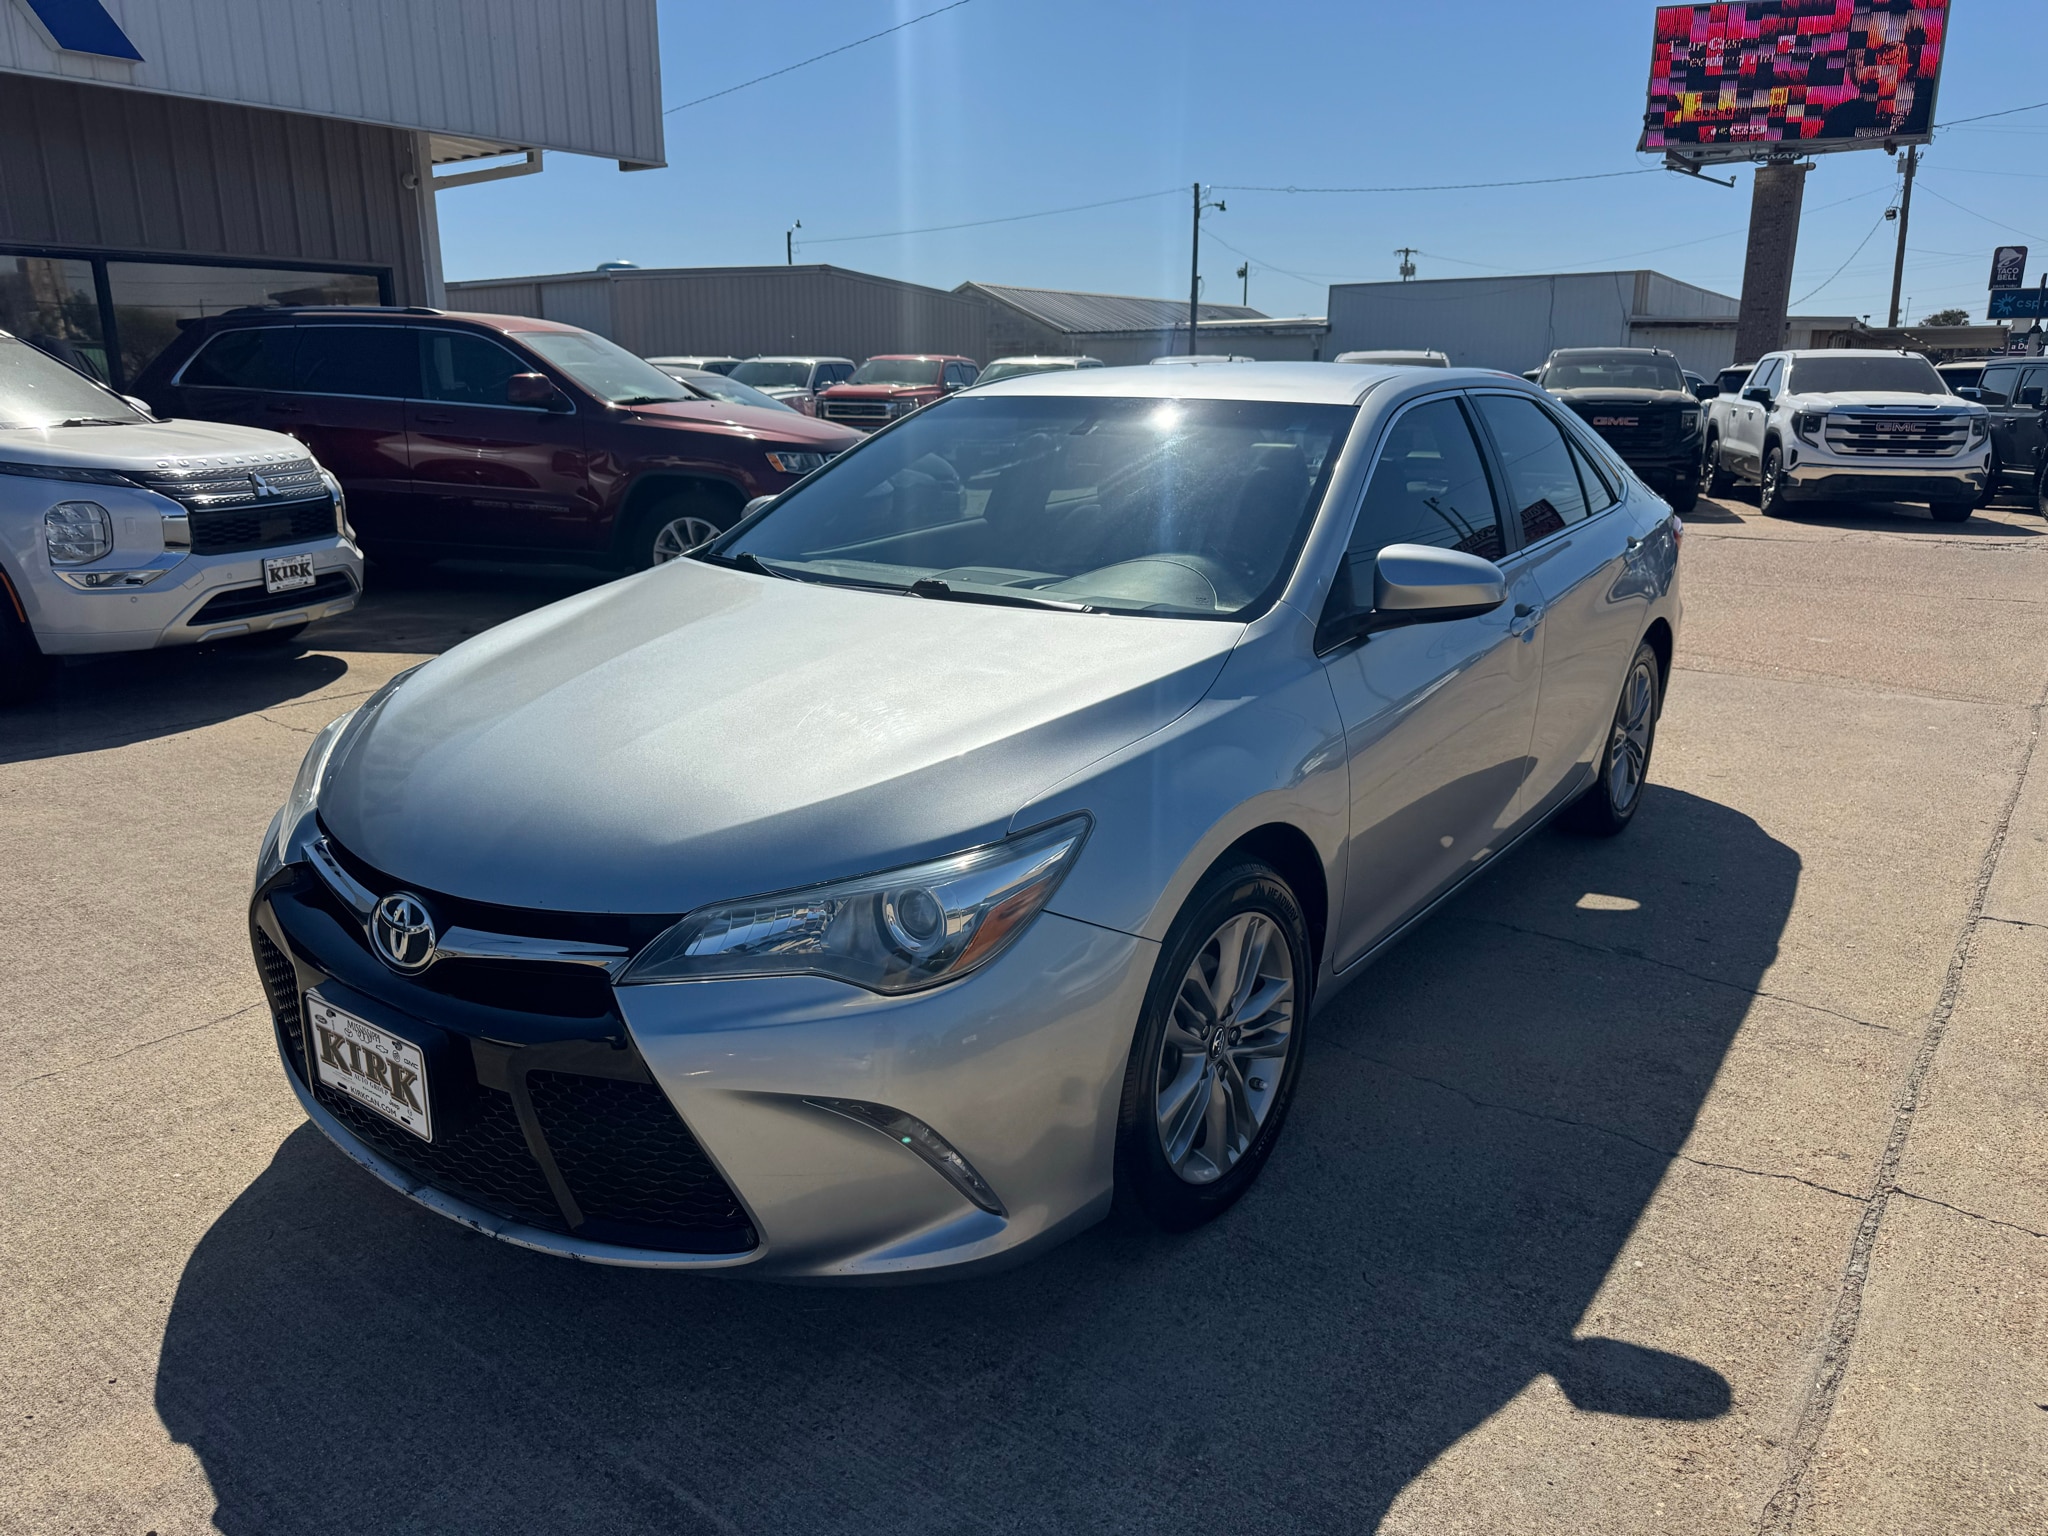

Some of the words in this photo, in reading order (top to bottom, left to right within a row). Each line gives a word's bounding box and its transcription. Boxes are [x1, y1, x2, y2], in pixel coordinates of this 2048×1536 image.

[1752, 152, 1801, 160] LAMAR
[1996, 273, 2018, 281] BELL
[1593, 416, 1639, 426] GMC
[1875, 421, 1927, 432] GMC
[156, 451, 299, 468] OUTLANDER
[268, 561, 312, 583] KIRK
[1267, 886, 1299, 921] HEADWAY
[346, 1019, 381, 1044] MISSISSIPPI
[315, 1023, 423, 1116] KIRK
[403, 1058, 419, 1070] GMC
[354, 1073, 369, 1085] AUTO
[350, 1086, 397, 1117] KIRKCAN.COM
